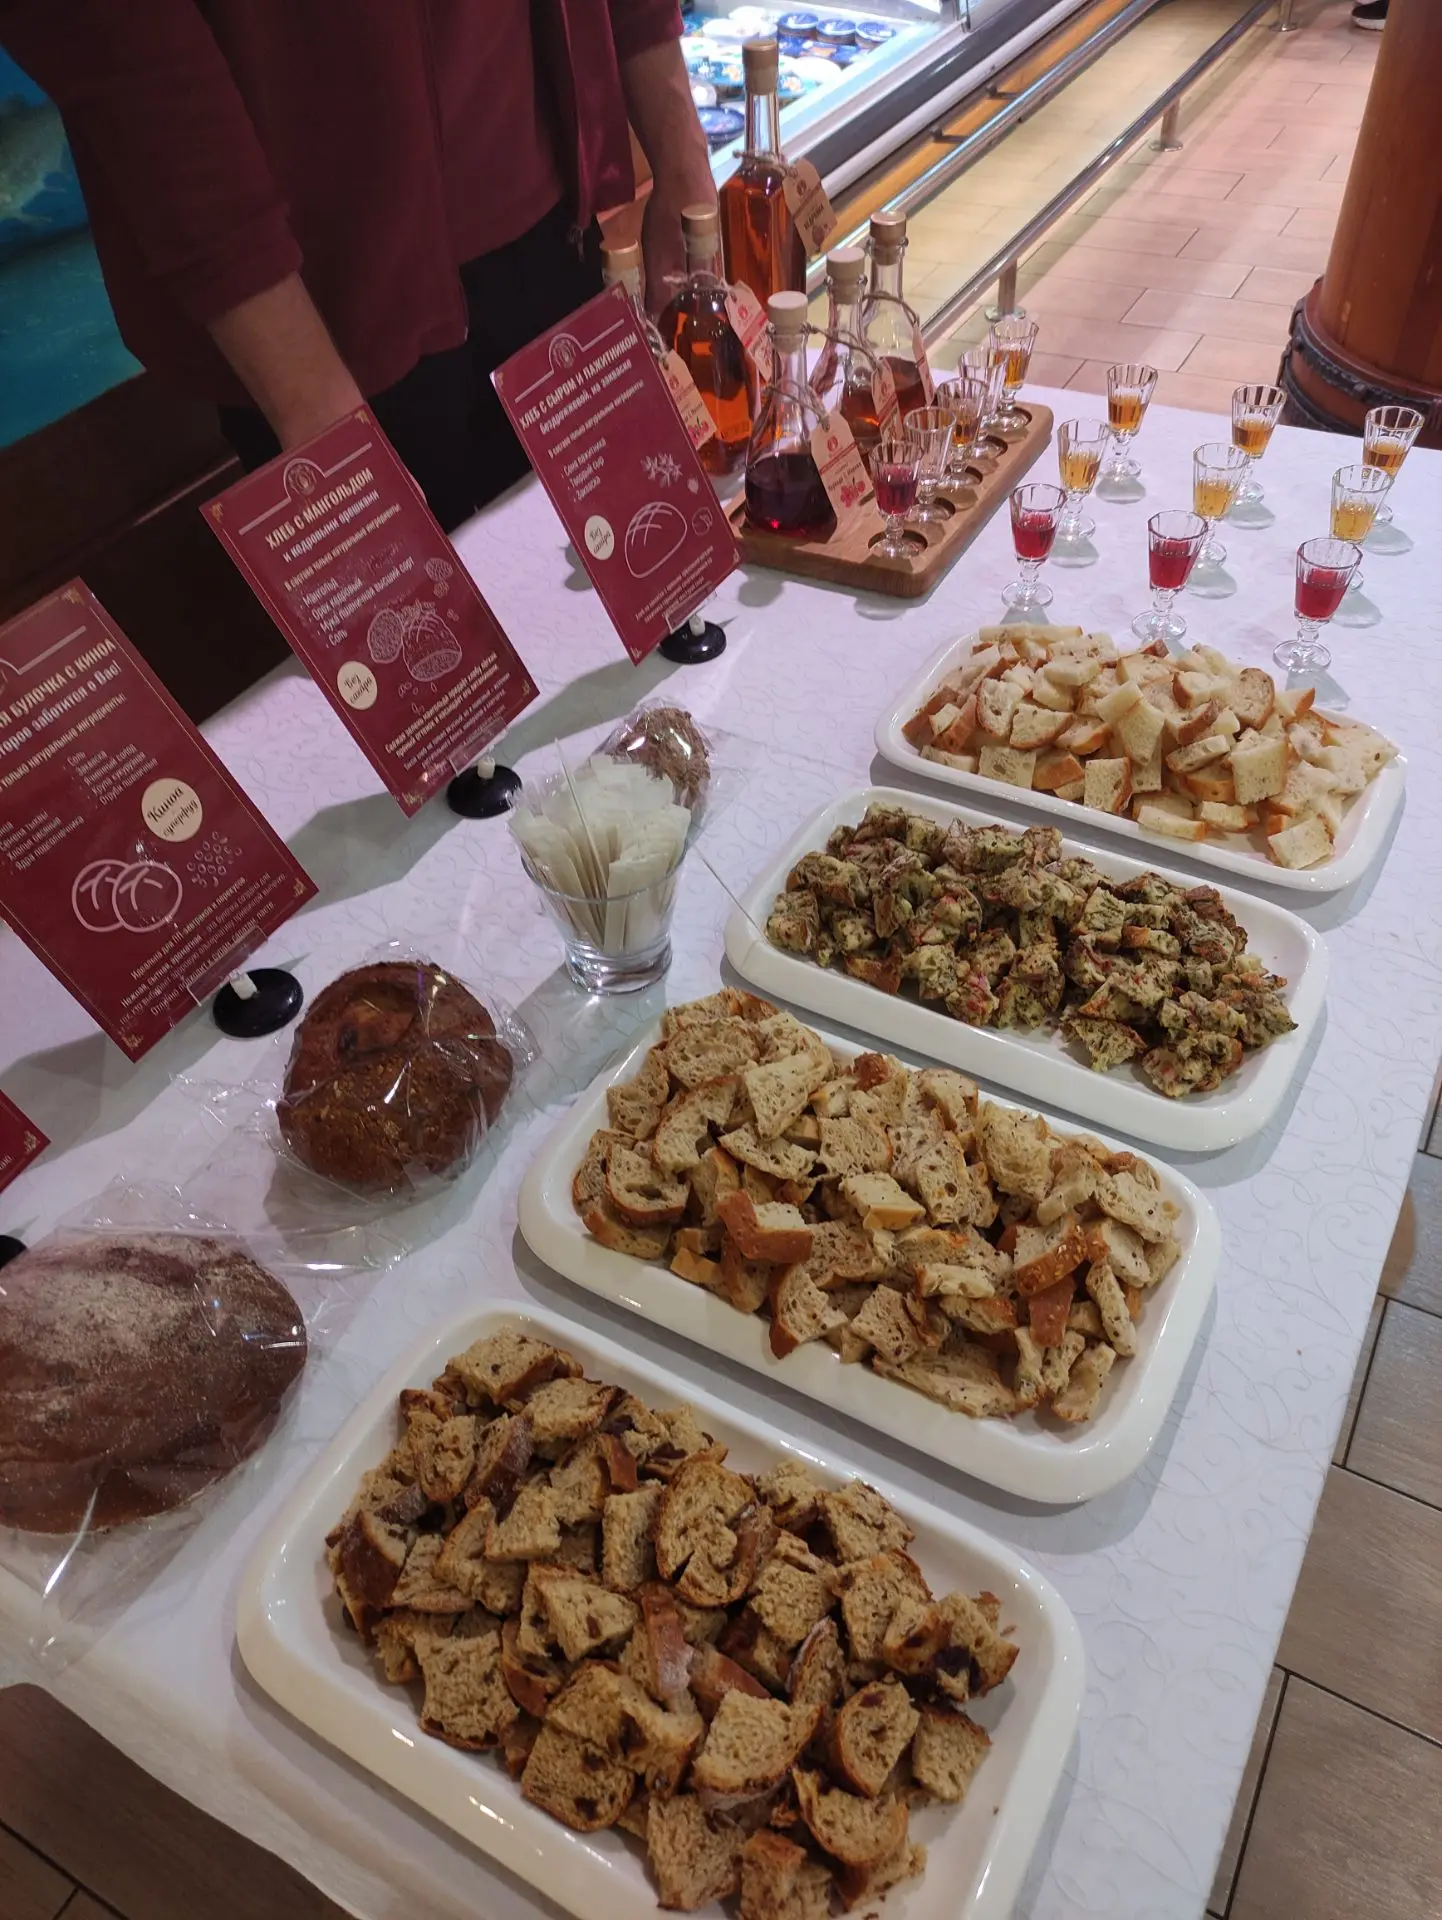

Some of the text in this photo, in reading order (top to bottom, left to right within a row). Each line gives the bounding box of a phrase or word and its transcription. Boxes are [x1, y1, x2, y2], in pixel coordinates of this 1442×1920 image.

[519, 406, 540, 429] ХЛЕБ
[546, 379, 576, 409] СЫРОМ
[583, 332, 637, 380] ПАЖИТНИКОМ
[591, 383, 602, 396] на
[600, 359, 631, 388] закваске
[264, 521, 296, 549] ХЛЕБ
[302, 467, 374, 524] МАНГОЛЬДОМ
[290, 518, 339, 557] кедровыми
[338, 489, 379, 523] орешками
[289, 565, 313, 586] составе
[312, 552, 332, 570] только
[331, 528, 366, 556] натуральные
[303, 577, 338, 606] Мангольд
[311, 576, 363, 620] Орех кедровый
[320, 556, 415, 633] Мука пшеничная высший сорт
[328, 627, 347, 645] Соль
[11, 672, 67, 717] БУЛОЧКА
[74, 638, 116, 672] КИНОА
[31, 684, 88, 732] заботится
[94, 660, 122, 685] Вас!
[0, 692, 126, 788] только натуральные ингредиенты:
[67, 748, 86, 766] Соль
[76, 750, 107, 776] Закваска
[84, 743, 136, 786] Ячменный солод
[91, 751, 147, 796] Крупа кукурузная
[99, 757, 158, 806] Отруби пшеничные
[25, 810, 48, 831] тыквы
[146, 787, 183, 823] Киноа
[162, 799, 198, 838] суперфуд
[14, 815, 84, 871] Ядра подсолнечника
[32, 817, 61, 842] овсяные
[131, 949, 162, 980] Идеальна
